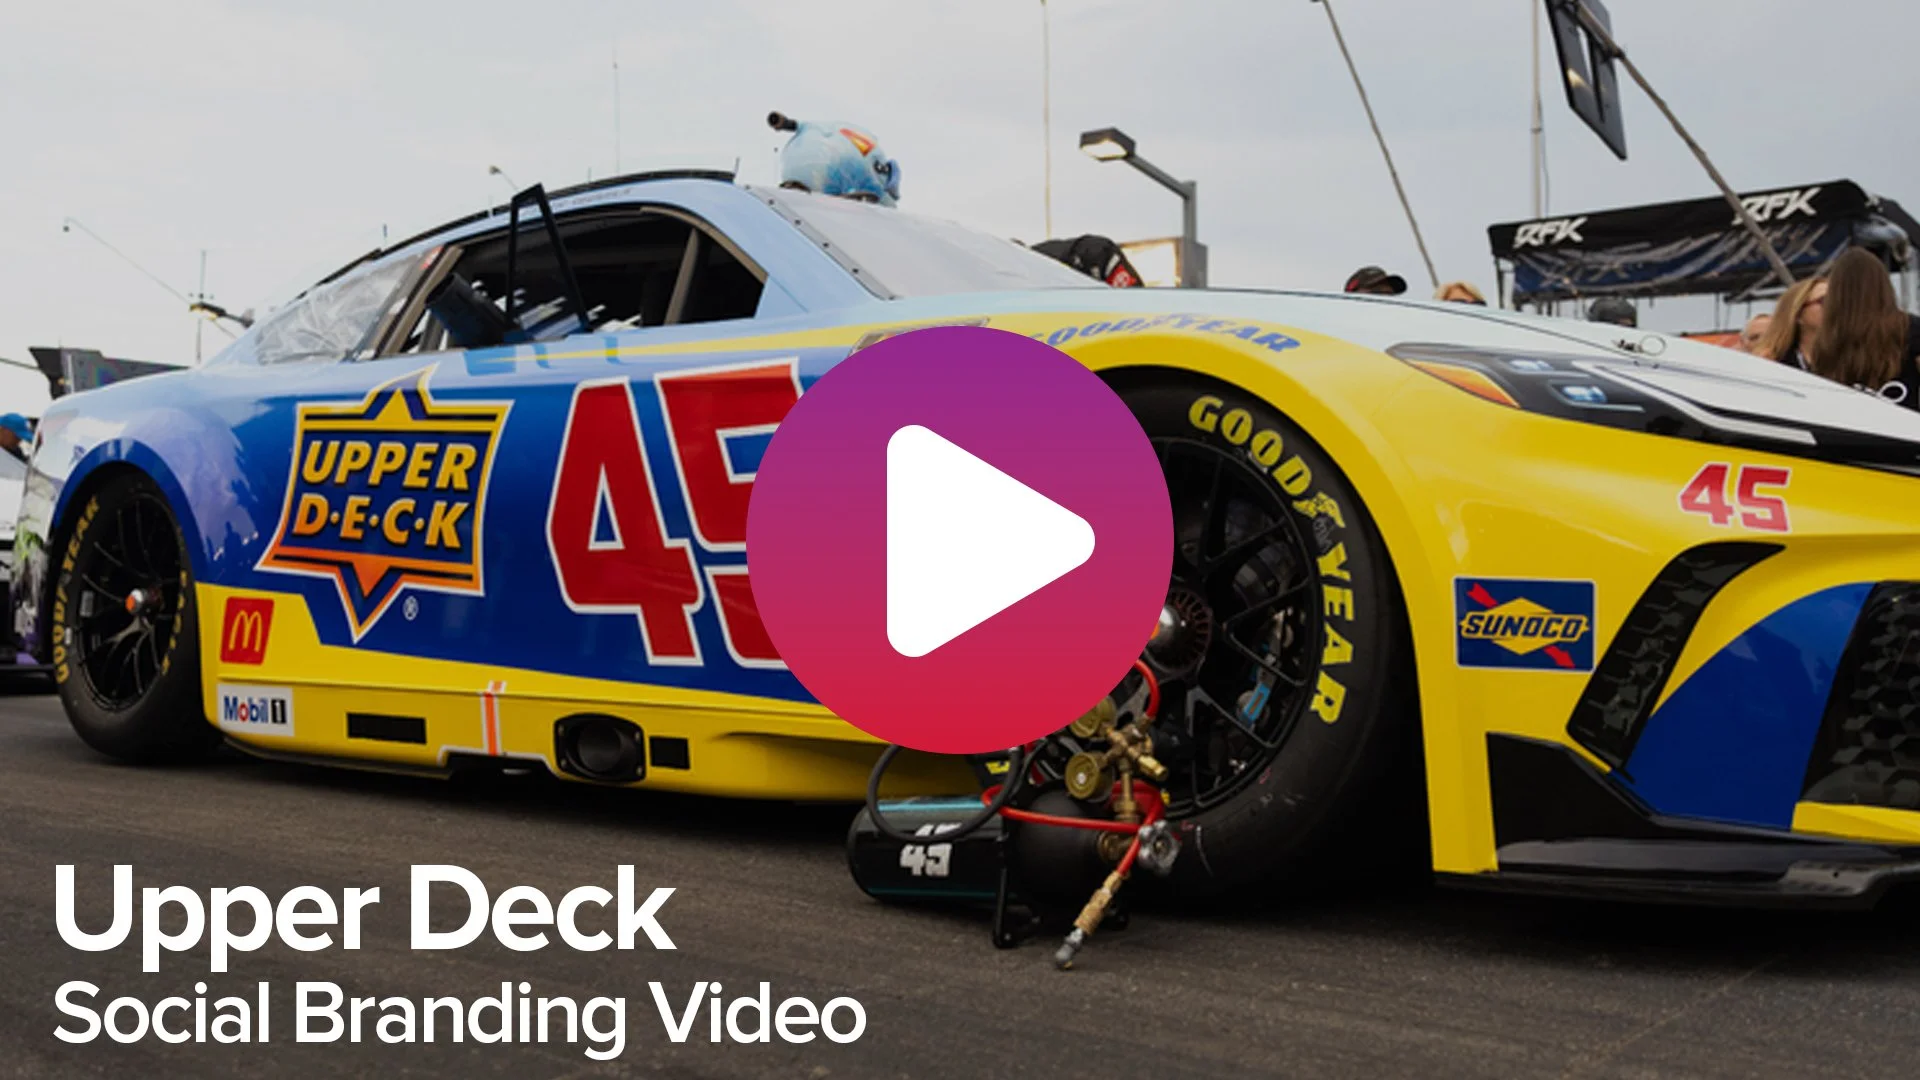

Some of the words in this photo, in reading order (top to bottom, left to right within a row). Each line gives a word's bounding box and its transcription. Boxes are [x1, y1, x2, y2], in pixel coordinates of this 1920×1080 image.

[1731, 187, 1821, 225] RFK
[1513, 216, 1588, 249] RFK
[302, 440, 477, 491] UPPER
[546, 356, 806, 672] 45
[1679, 463, 1791, 533] 45
[1465, 613, 1584, 639] SUNOCO
[223, 695, 269, 724] Mobil
[270, 698, 287, 724] 1
